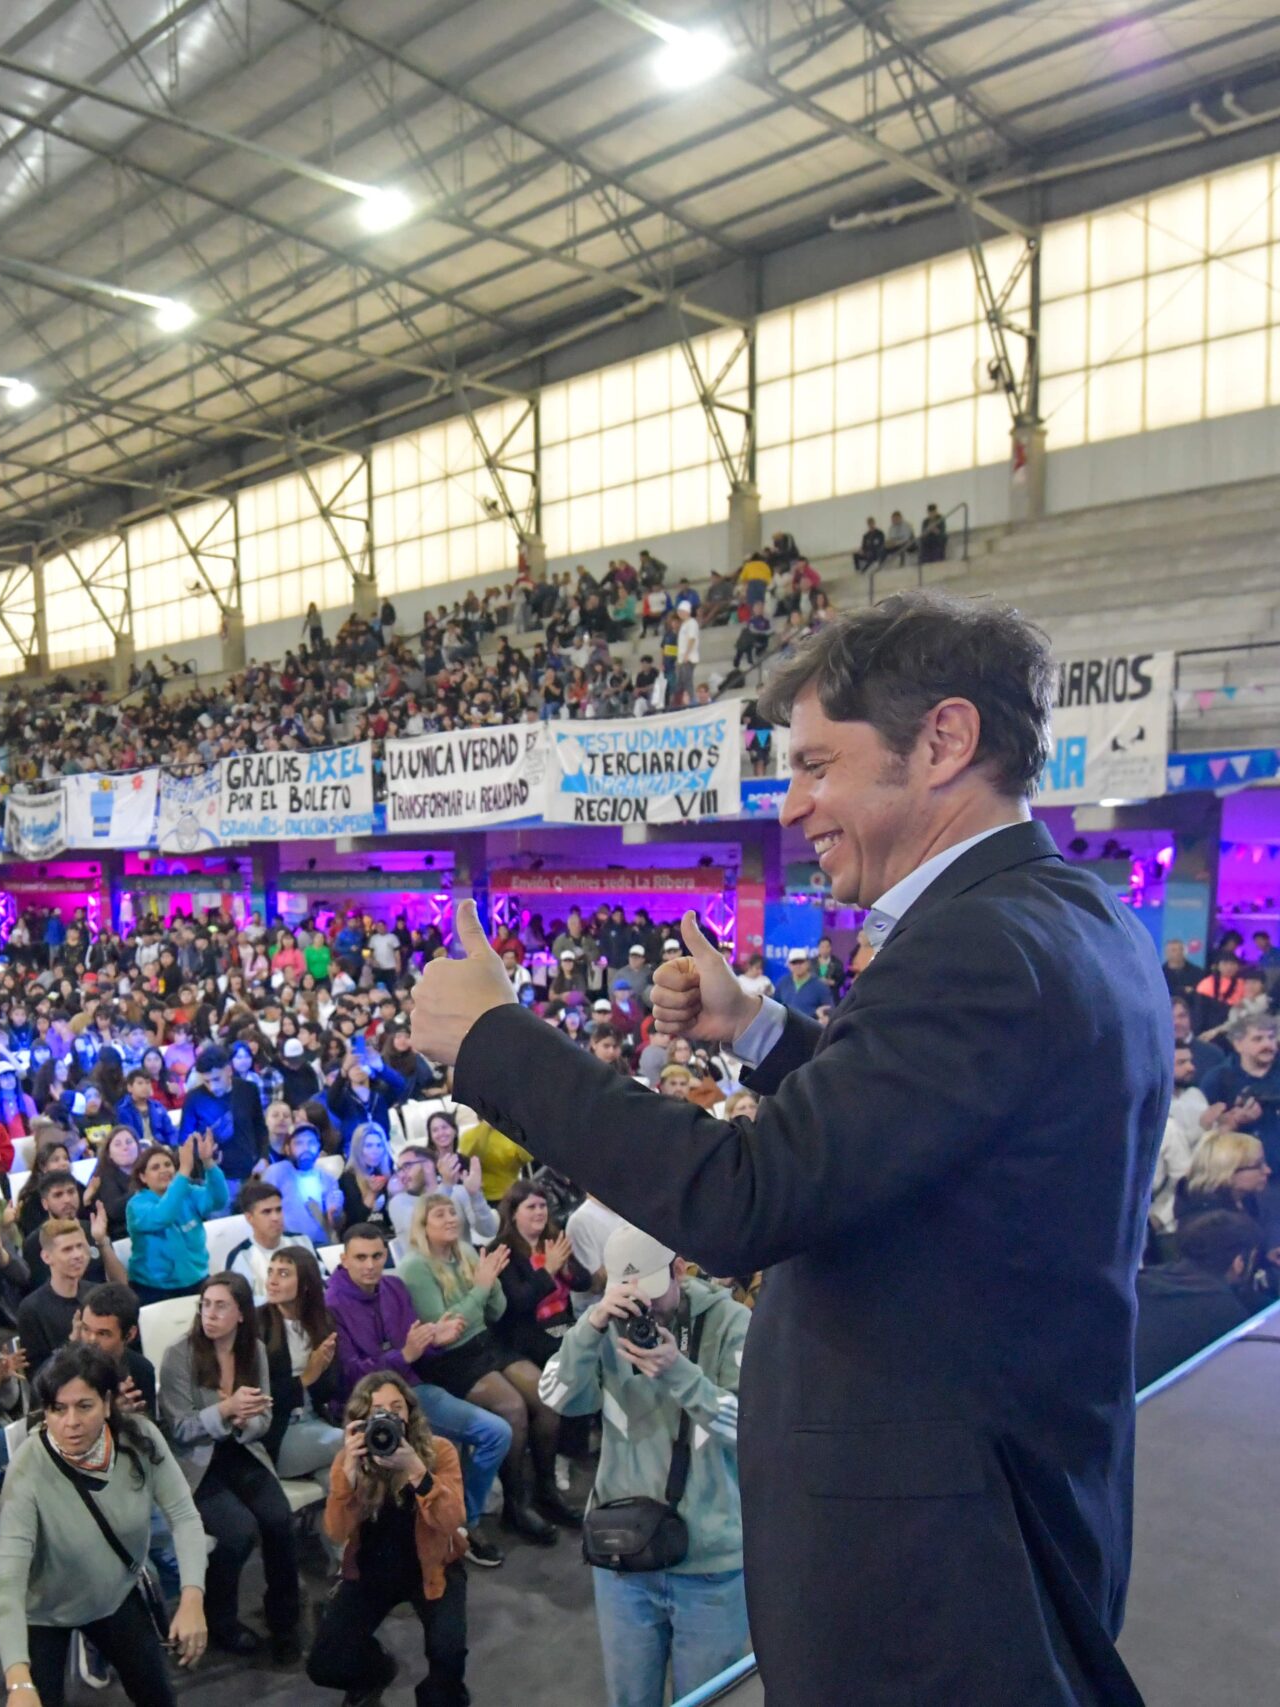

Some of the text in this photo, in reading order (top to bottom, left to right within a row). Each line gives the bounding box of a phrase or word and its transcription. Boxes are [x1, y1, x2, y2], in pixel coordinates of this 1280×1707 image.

[1054, 653, 1154, 708] IARIOS
[584, 719, 727, 751] ESTUDIANTES
[227, 755, 301, 789] GRACIAS
[306, 746, 365, 783] AXEL
[389, 751, 406, 780] LA
[408, 742, 455, 778] UNICA
[459, 732, 519, 773] VERDAD
[587, 744, 720, 776] TERCIARIOS
[227, 785, 351, 813] POR EL BOLETO
[390, 778, 530, 821] TRANSFORMAR LA REALIDAD
[574, 797, 648, 822] REGION
[675, 789, 718, 817] VIII
[553, 875, 601, 890] Quilmes
[635, 875, 649, 889] La
